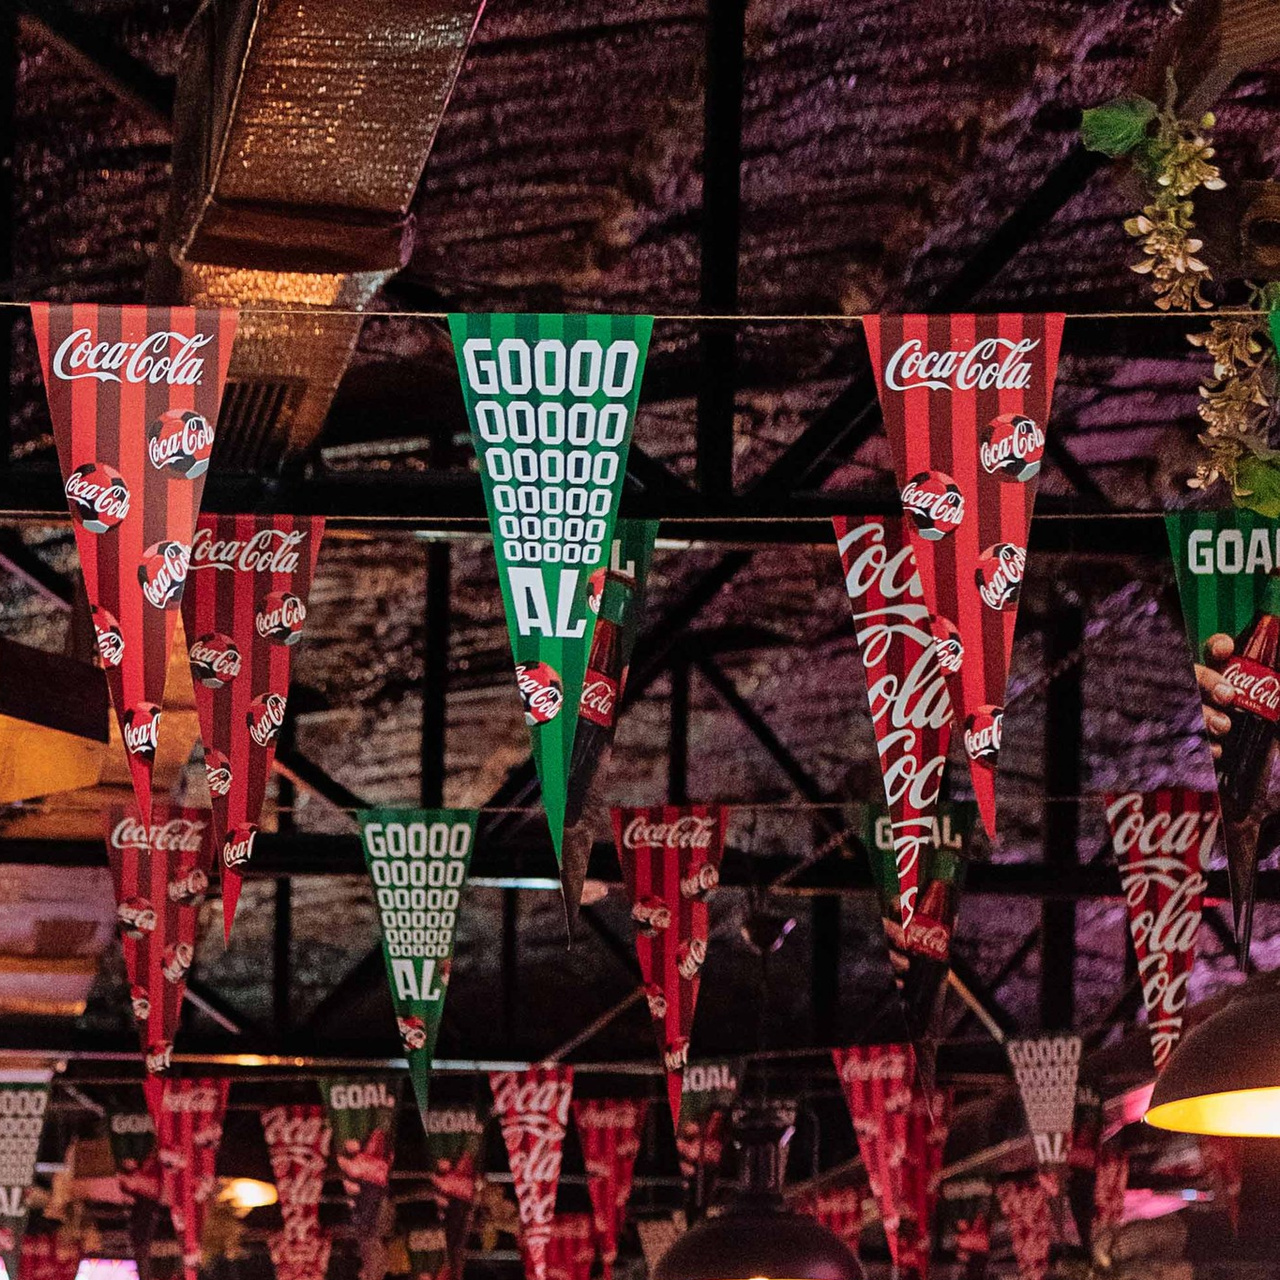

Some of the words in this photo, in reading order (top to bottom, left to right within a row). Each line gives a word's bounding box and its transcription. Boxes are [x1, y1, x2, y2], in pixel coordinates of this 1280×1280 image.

[53, 328, 214, 386] Coca-Cola
[462, 338, 640, 398] GOOOO
[885, 338, 1040, 393] Coca-Cola
[474, 400, 629, 447] OOOOO
[484, 446, 619, 486] OOOOO
[492, 485, 613, 517] OOOOO
[498, 514, 607, 544] OOOOO
[186, 529, 307, 574] Coca-Cola
[503, 540, 602, 565] OOOOO
[1188, 529, 1280, 575] GOA
[507, 566, 587, 639] AL
[364, 822, 472, 859] GOOOO
[623, 815, 717, 851] Coca-Cola
[391, 958, 441, 1002] AL
[329, 1084, 396, 1110] GOAL
